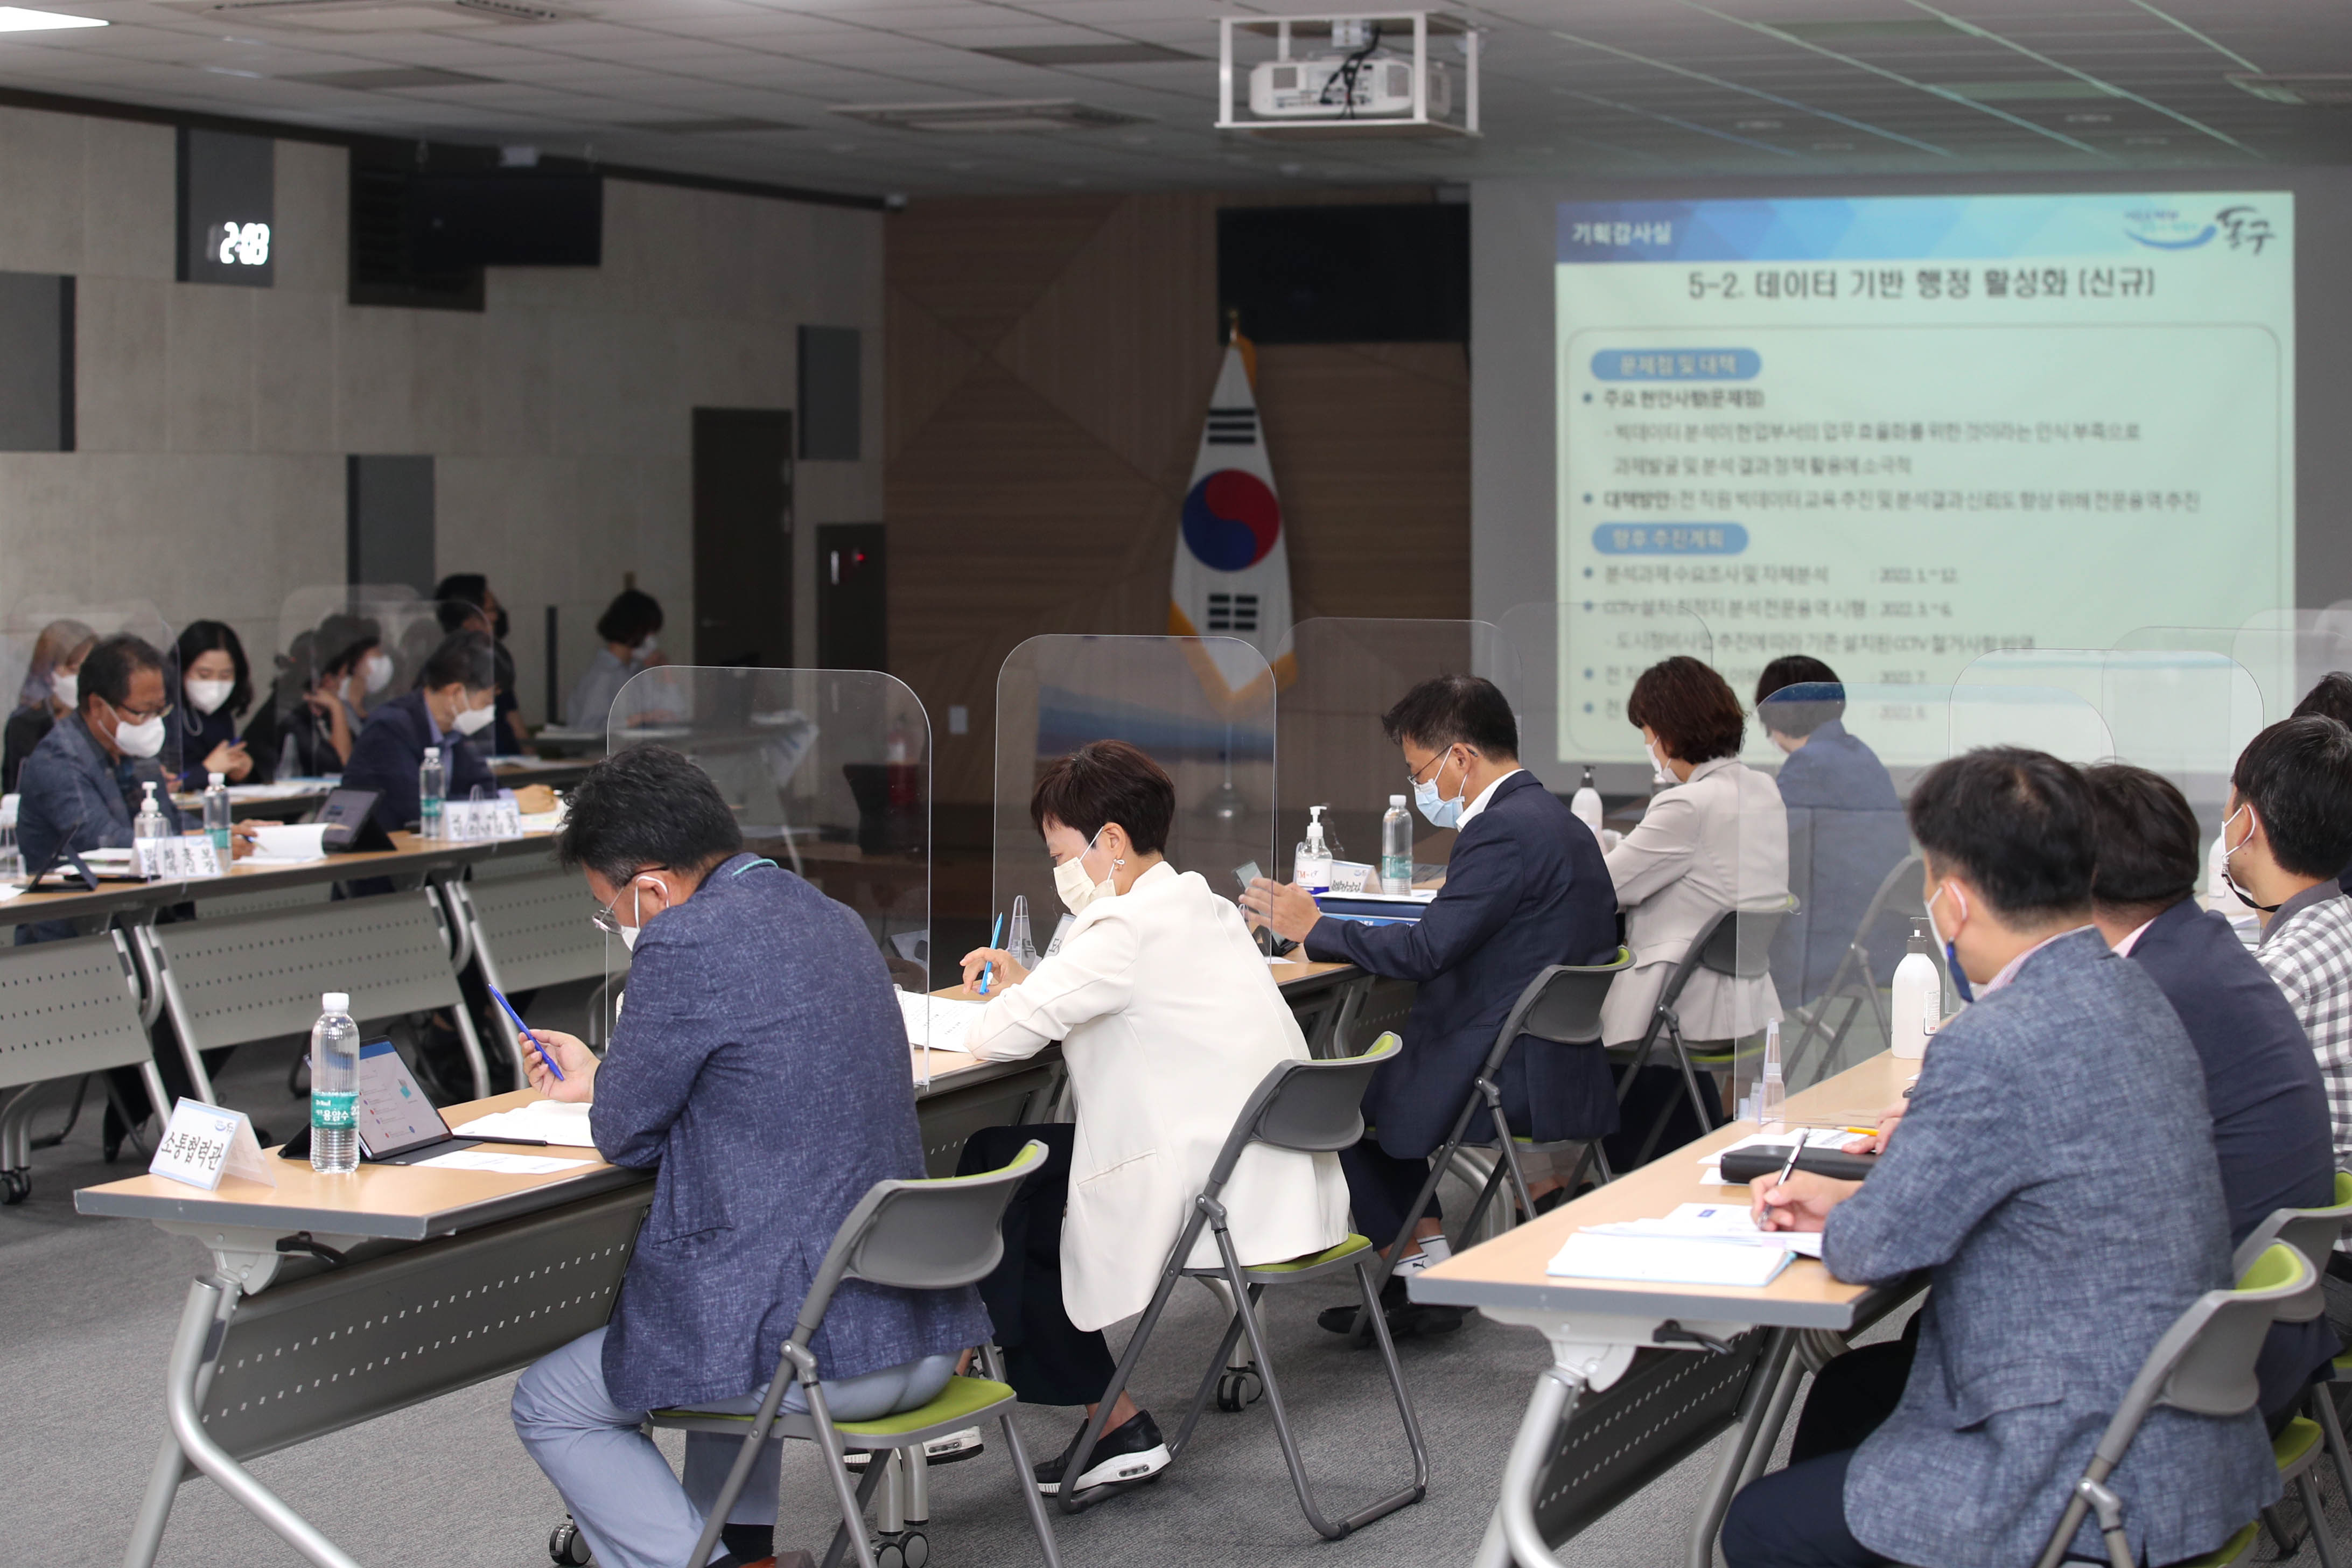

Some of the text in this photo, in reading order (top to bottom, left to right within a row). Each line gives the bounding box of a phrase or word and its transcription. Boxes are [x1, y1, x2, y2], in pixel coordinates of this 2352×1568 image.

[1572, 221, 1673, 247] 기획감사실
[1688, 271, 1745, 299] 5-2.
[1754, 270, 1838, 299] 데이터
[1850, 269, 1905, 299] 기반
[1915, 268, 1971, 299] 행정
[1984, 268, 2067, 299] 활성화
[323, 1108, 349, 1122] 용암수
[161, 1131, 224, 1171] 소통협력관
